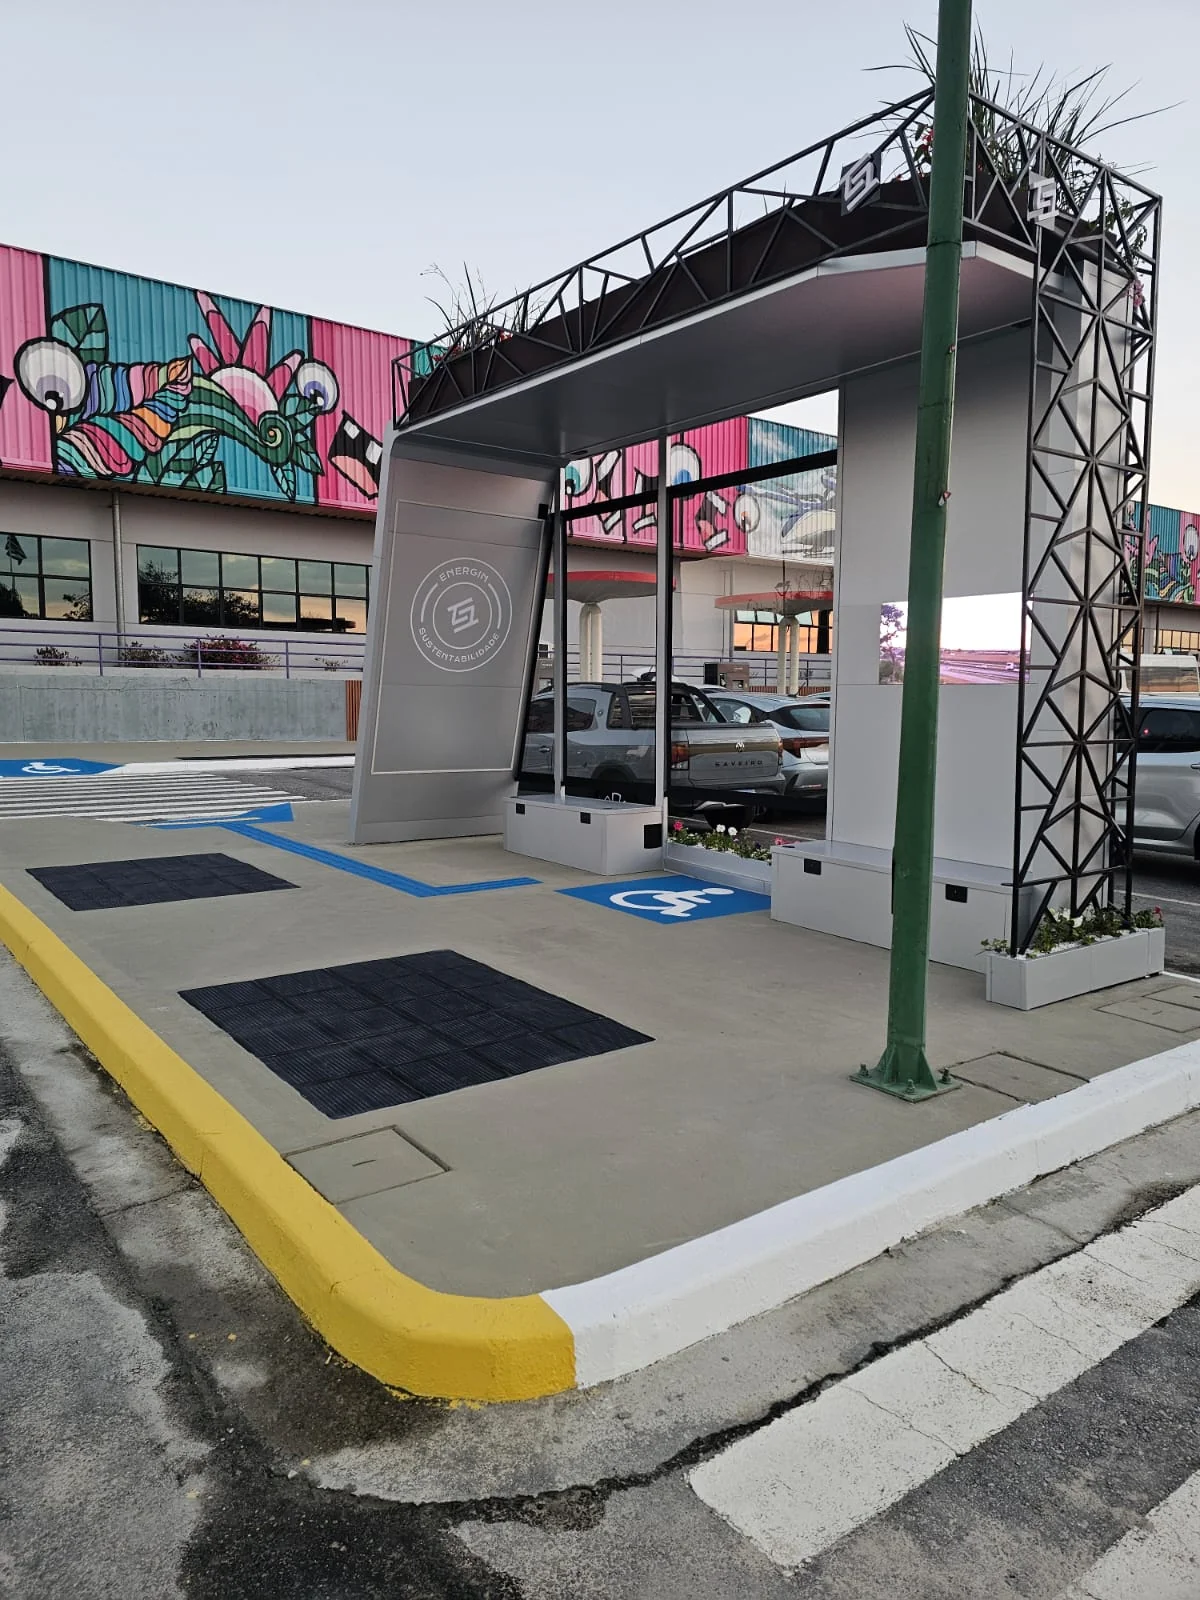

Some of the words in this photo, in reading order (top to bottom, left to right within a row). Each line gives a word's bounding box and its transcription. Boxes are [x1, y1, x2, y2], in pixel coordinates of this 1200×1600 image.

[439, 566, 489, 582] ENERGIN
[419, 627, 500, 663] SUSTENTABILIDADE
[714, 759, 763, 767] SAVEIRO
